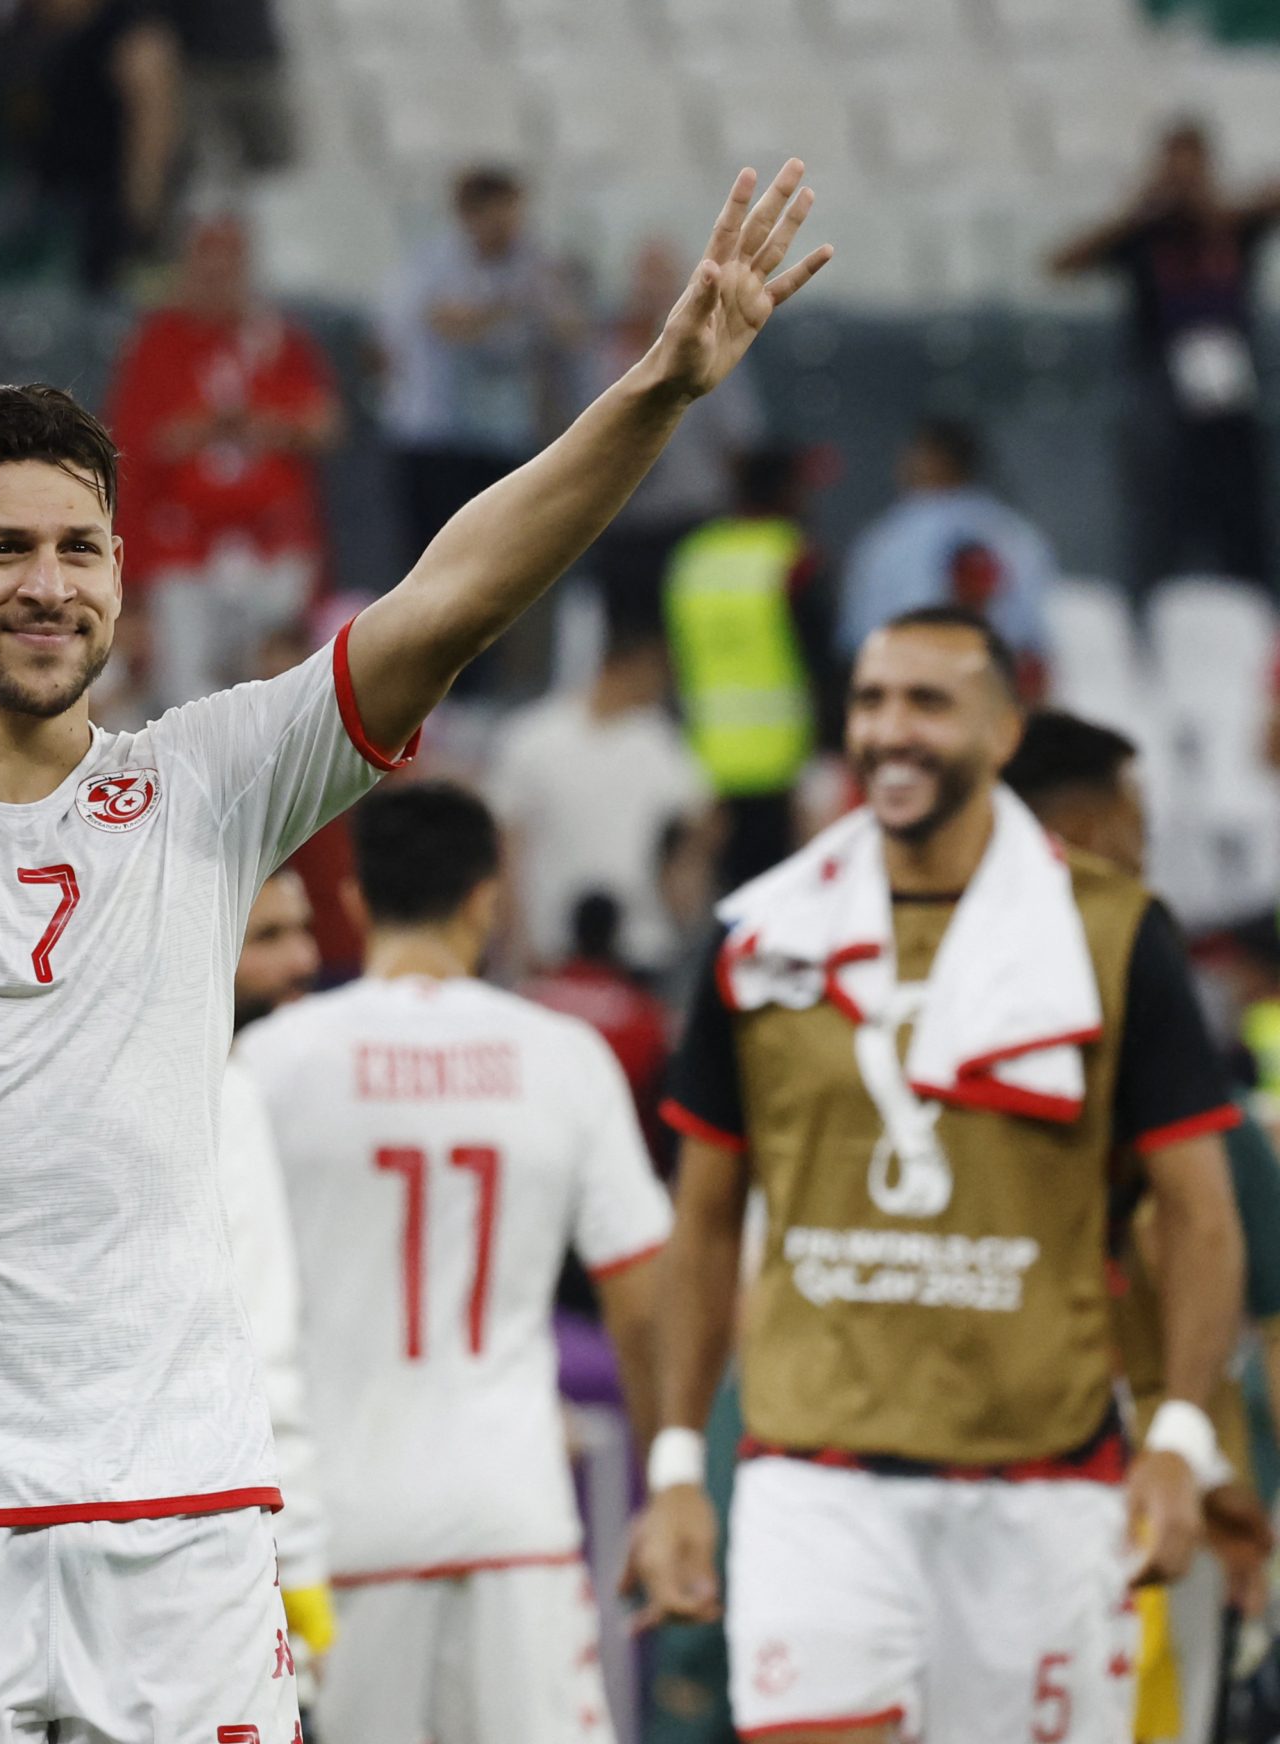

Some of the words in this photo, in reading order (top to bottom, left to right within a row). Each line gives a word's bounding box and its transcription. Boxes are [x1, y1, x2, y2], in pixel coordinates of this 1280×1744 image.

[17, 864, 80, 983] 7
[373, 1145, 501, 1358] 11
[1032, 1652, 1073, 1744] 5
